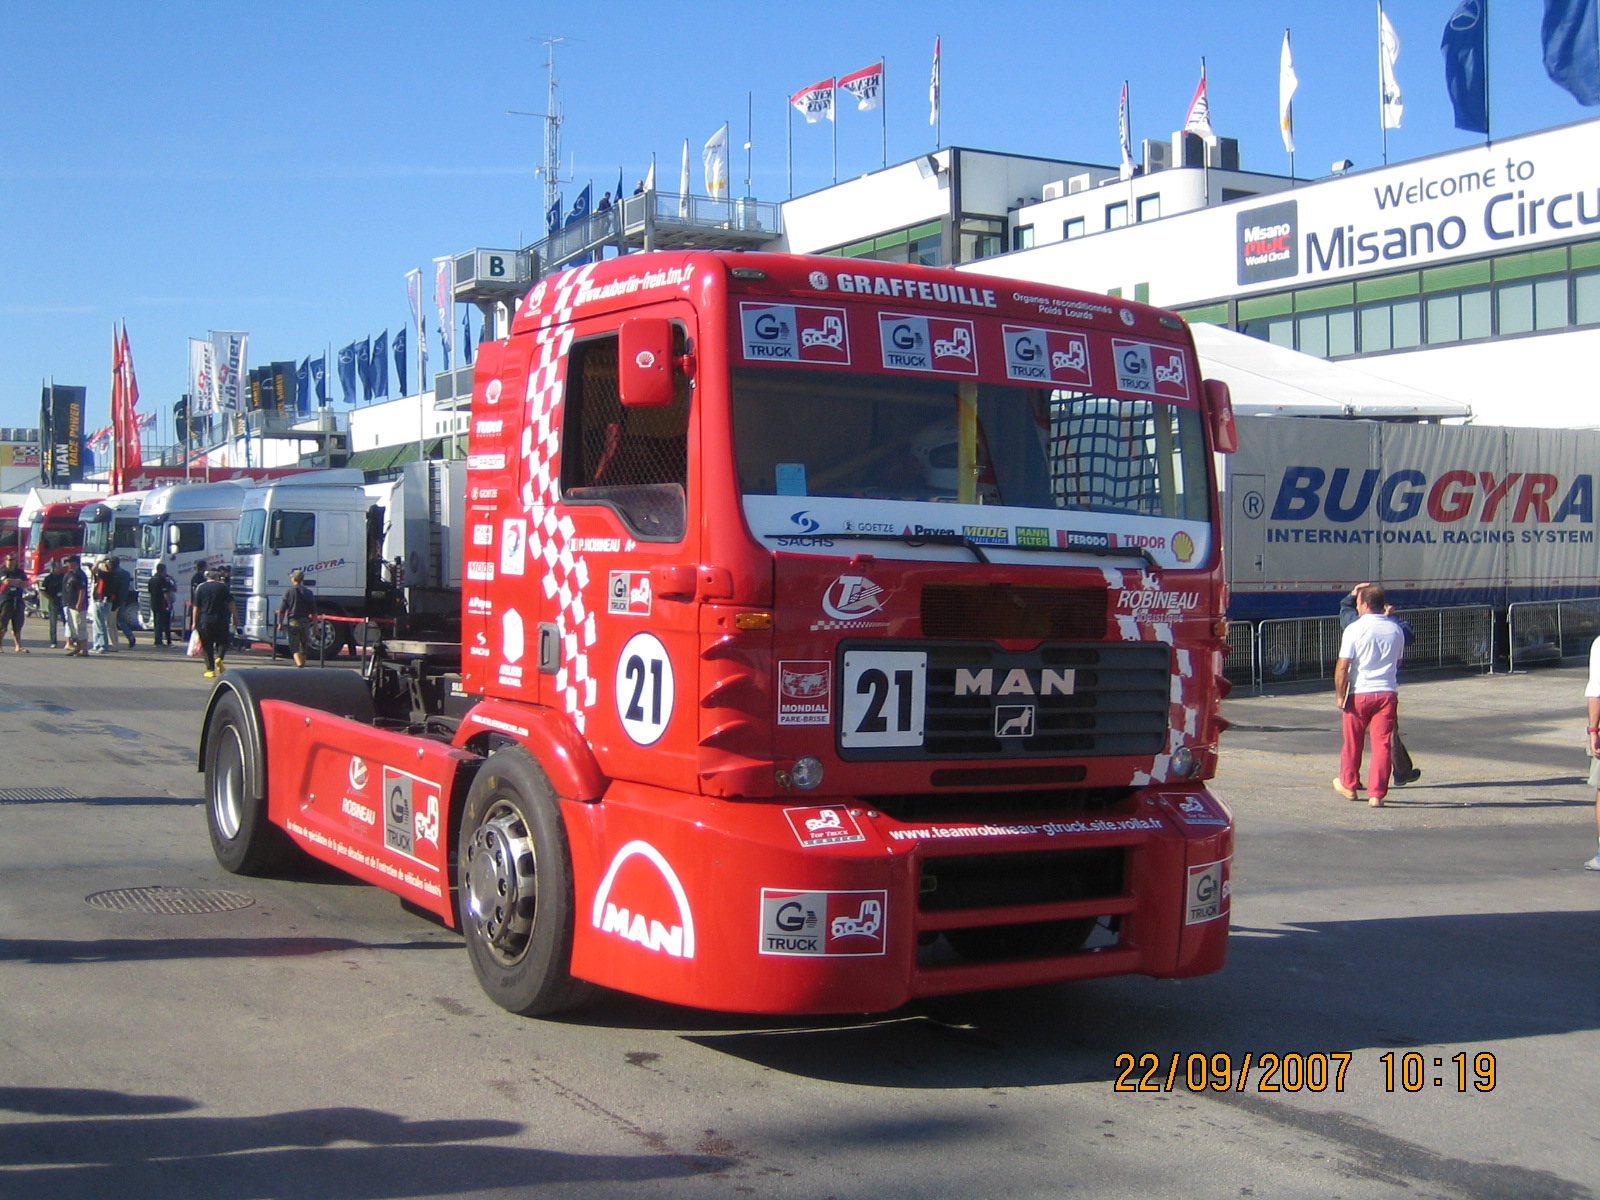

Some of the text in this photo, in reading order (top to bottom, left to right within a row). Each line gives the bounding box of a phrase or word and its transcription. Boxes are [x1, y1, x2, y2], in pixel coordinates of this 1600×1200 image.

[1374, 157, 1535, 211] Welcome to
[1244, 223, 1291, 243] Misano
[1306, 187, 1600, 274] Misano Circu
[1245, 249, 1291, 266] World Circuit
[490, 256, 505, 276] B
[837, 273, 998, 308] GRAFFEUILLE
[1013, 292, 1050, 304] Organes
[1039, 305, 1093, 320] Poids Lourds
[749, 345, 792, 358] TRUCK
[888, 354, 926, 367] TRUCK
[1011, 365, 1047, 378] TRUCK
[1120, 377, 1151, 390] TRUCK
[68, 403, 80, 466] RACE POWER
[56, 443, 71, 476] MAN
[1270, 465, 1594, 523] BUGGYRA
[857, 522, 894, 533] GOETZE
[963, 526, 1007, 538] MOOG
[1017, 528, 1048, 537] MANN
[777, 535, 834, 547] SACHS
[1018, 537, 1048, 546] FILTER
[1067, 534, 1107, 547] FERODO
[1123, 534, 1165, 549] TUDOR
[1267, 528, 1594, 544] INTERNATIONAL RACING SYSTEM
[1117, 590, 1199, 609] ROBINEAU
[625, 654, 663, 725] 21
[954, 668, 1076, 696] MAN
[854, 668, 914, 733] 21
[781, 704, 828, 713] MONDIAL
[780, 715, 827, 723] PARE-BRISE
[889, 817, 1163, 841] www.teamrobineau-gtruck.site.voila.fr
[387, 828, 411, 852] TRUCK
[1190, 907, 1218, 920] TRUCK
[602, 902, 684, 957] MAN
[767, 937, 818, 951] TRUCK
